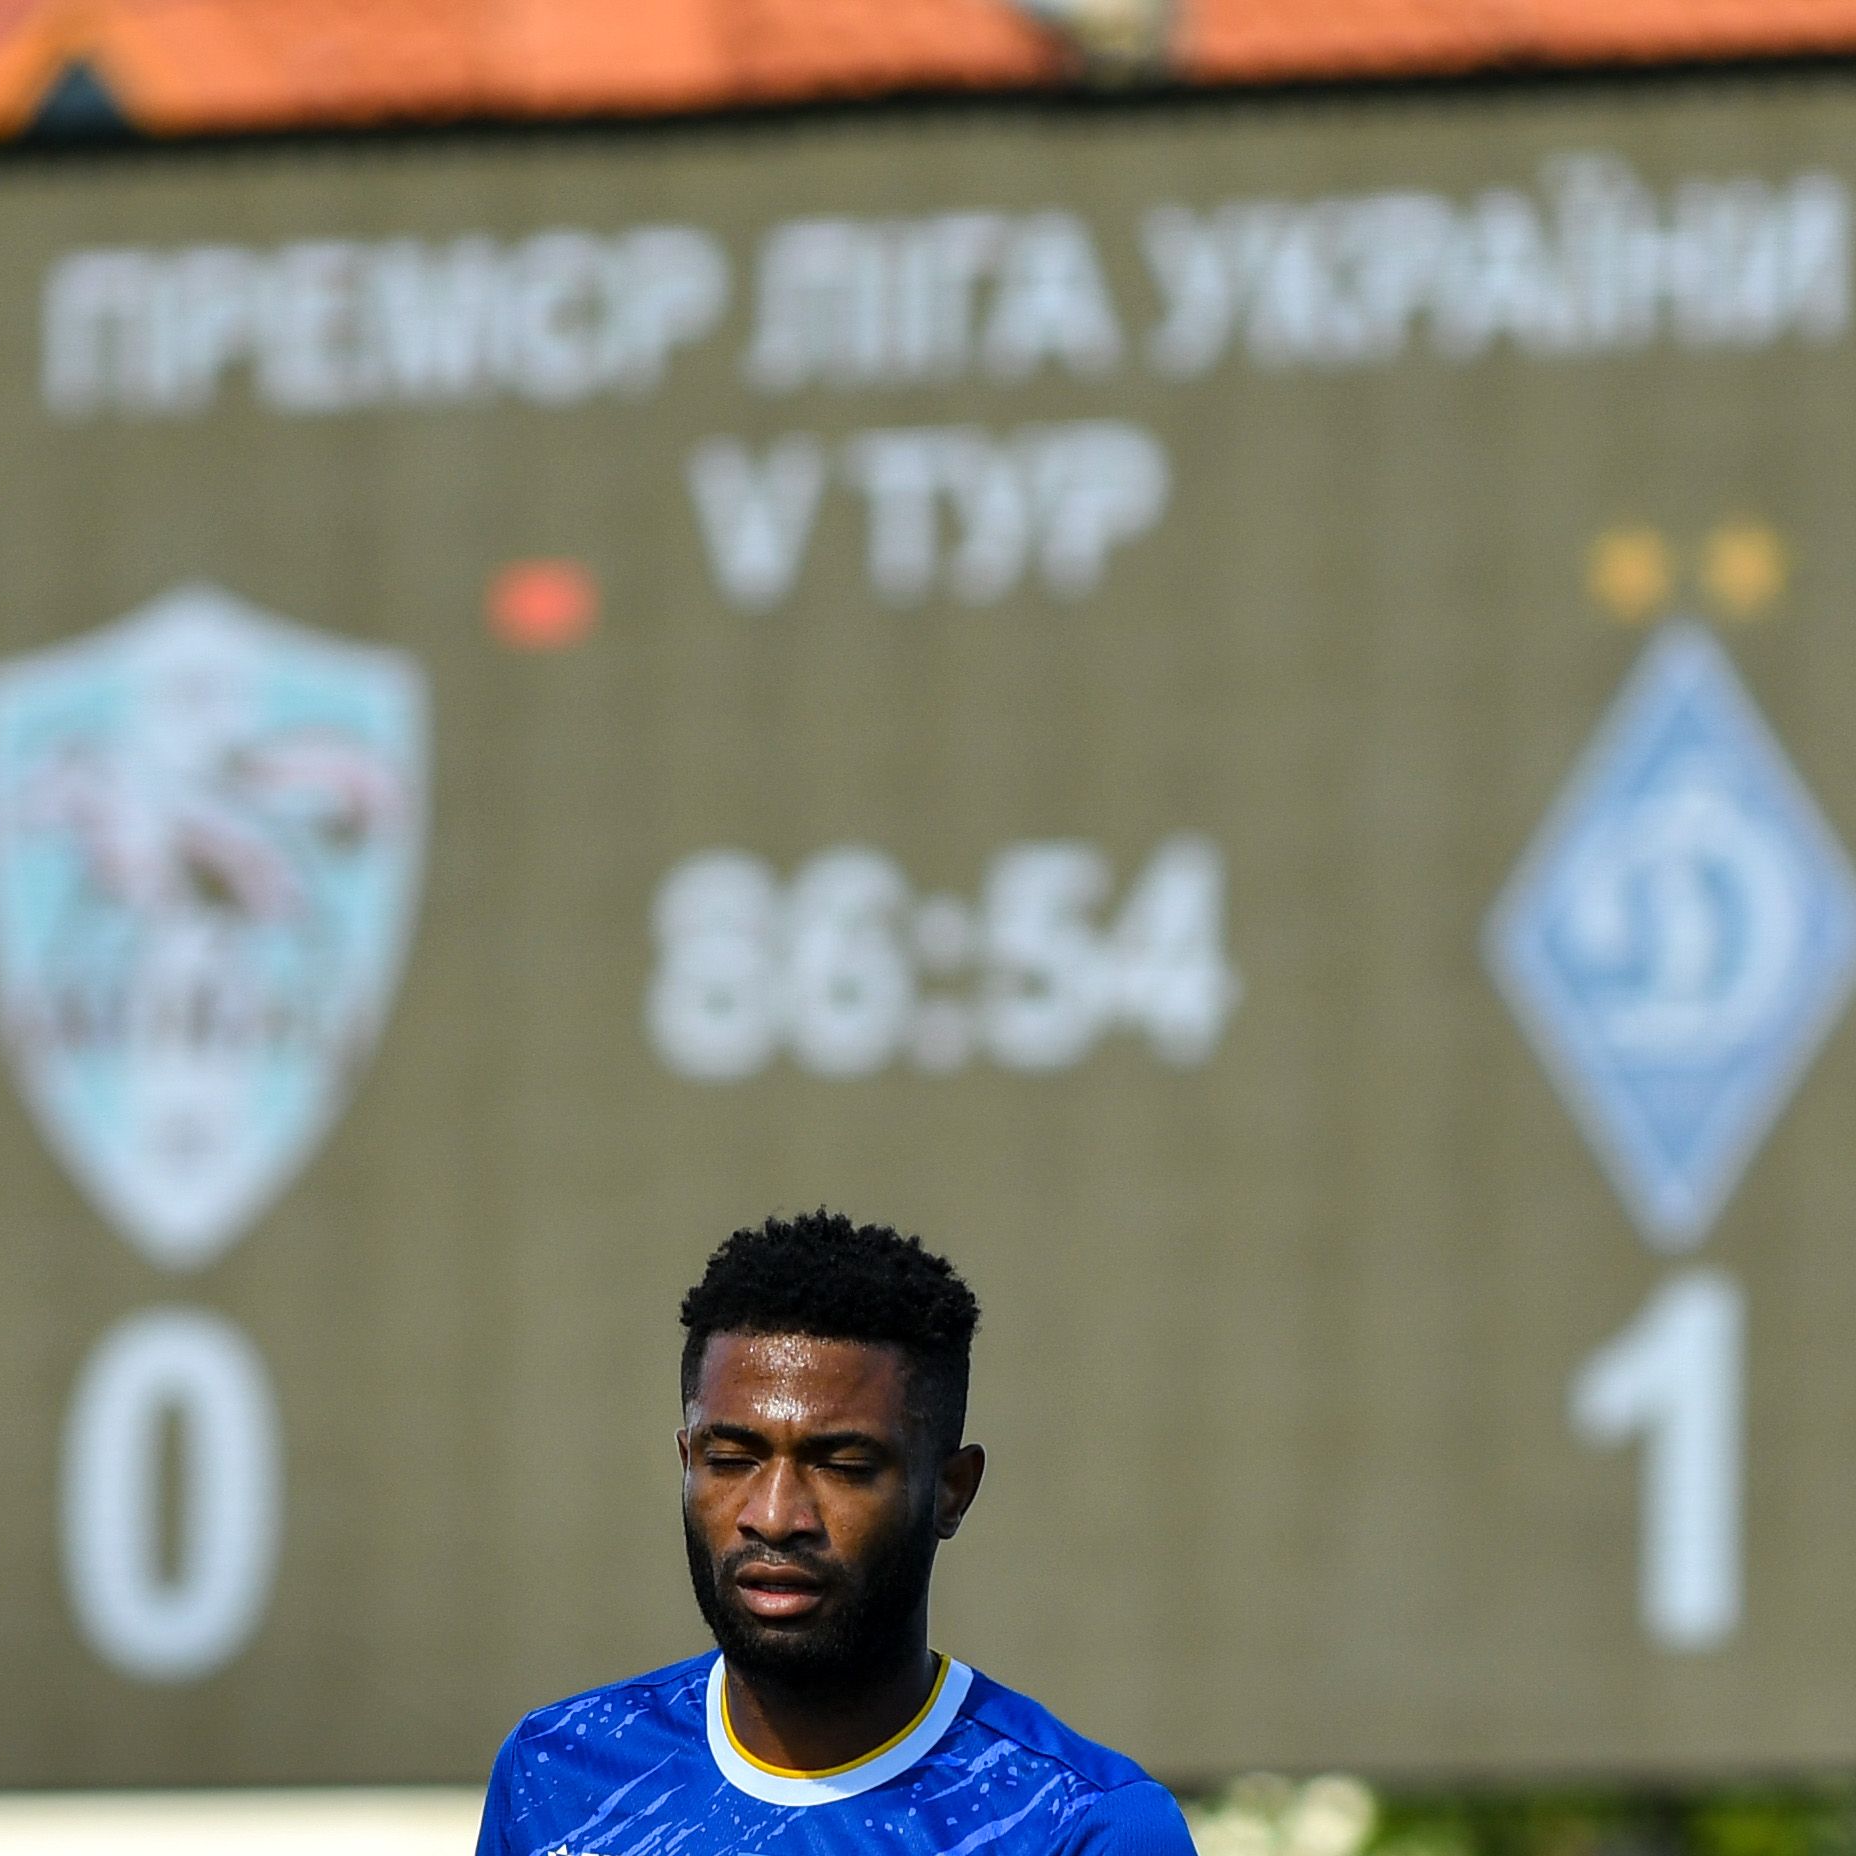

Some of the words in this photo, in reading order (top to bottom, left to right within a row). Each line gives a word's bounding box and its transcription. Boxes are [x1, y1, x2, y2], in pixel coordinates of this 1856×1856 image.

[748, 210, 1124, 396] ЛІГА
[1144, 150, 1854, 380] УКРАЇНИ
[689, 435, 826, 612] V
[850, 418, 1172, 606] ТУР
[644, 838, 1242, 1084] 86:54
[58, 1306, 286, 1685] 0
[1568, 1268, 1749, 1656] 1
